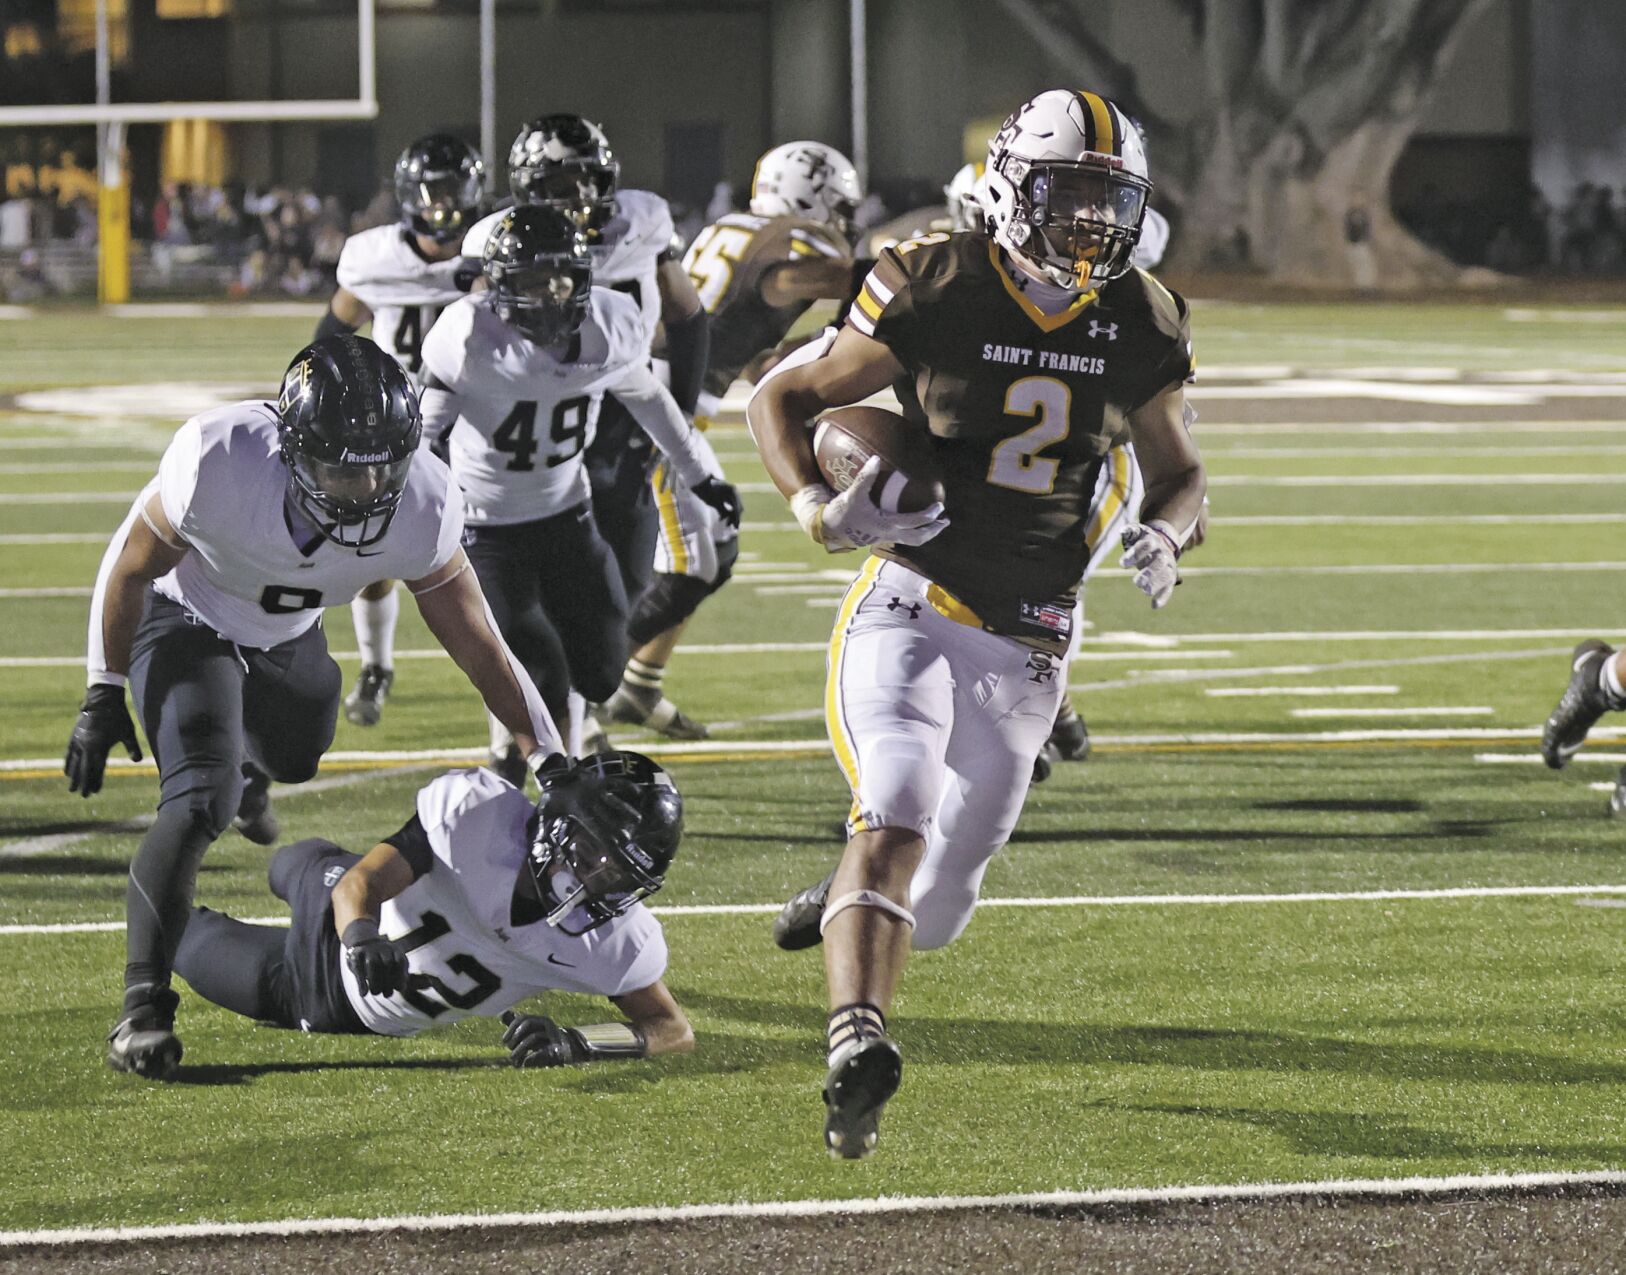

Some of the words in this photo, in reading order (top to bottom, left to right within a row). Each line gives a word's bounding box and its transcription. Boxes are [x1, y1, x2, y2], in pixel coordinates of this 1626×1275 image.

[982, 343, 1033, 366] SAINT
[1039, 350, 1106, 375] FRANCIS
[347, 450, 389, 463] Riddell
[493, 391, 592, 471] 49
[985, 375, 1072, 495] 2
[395, 910, 502, 1020] 12
